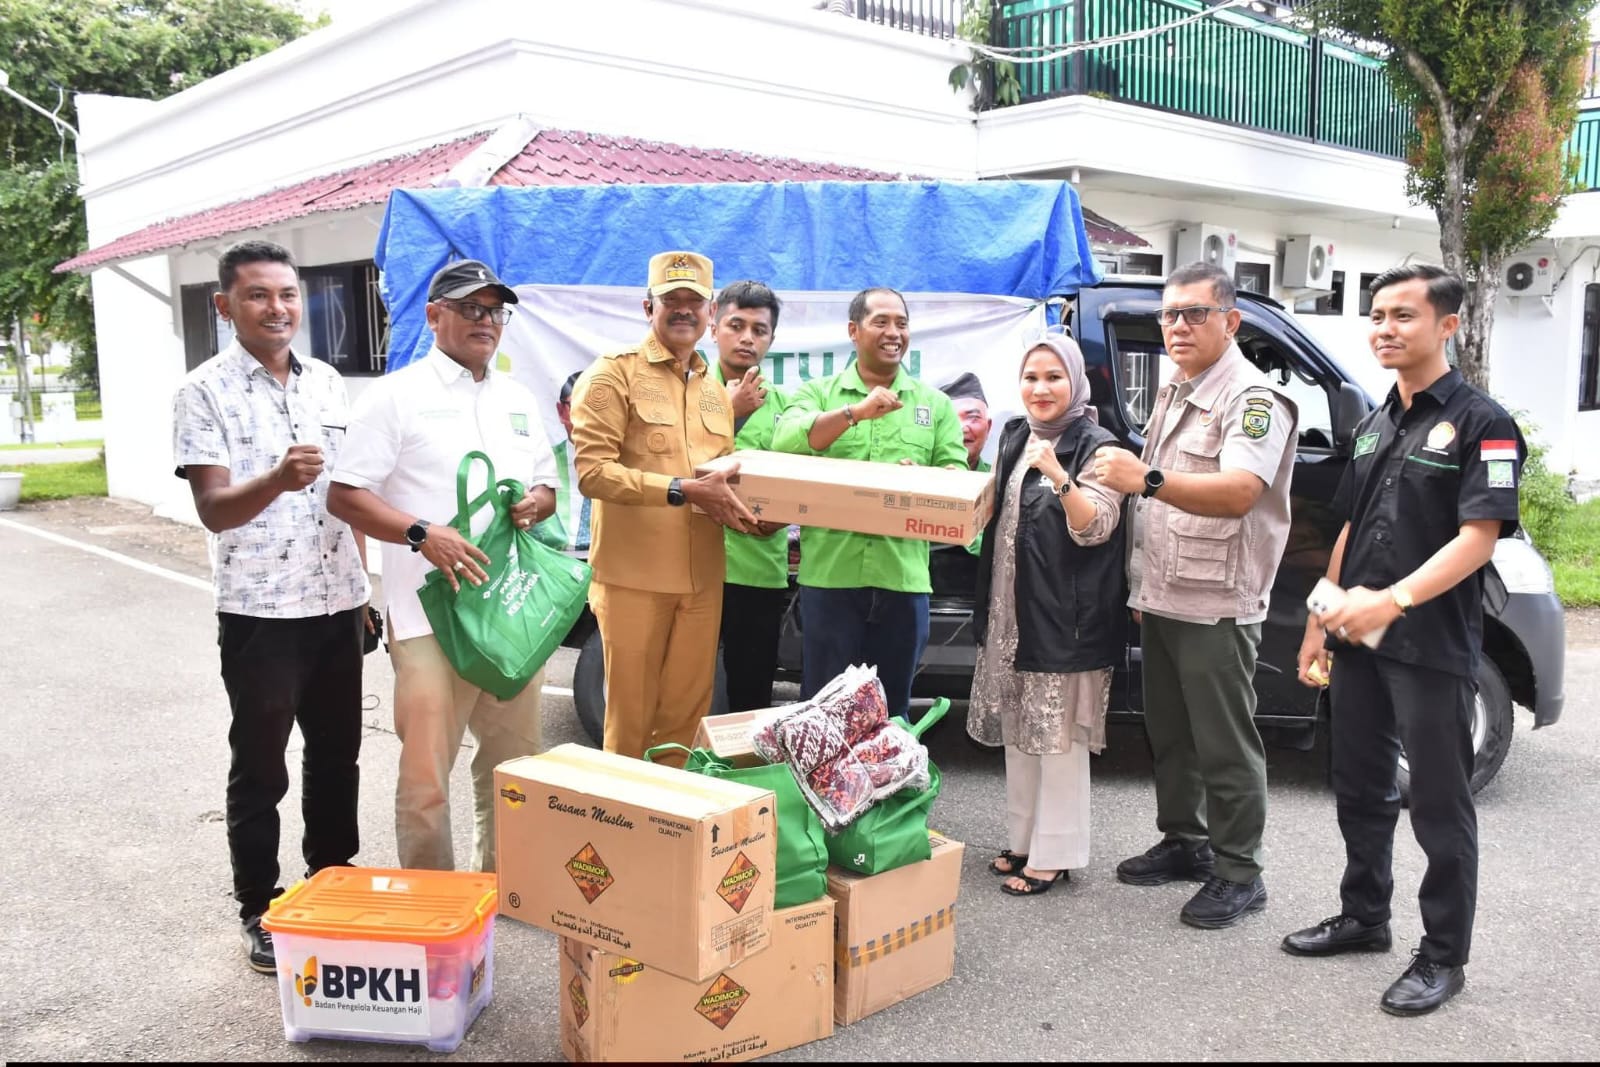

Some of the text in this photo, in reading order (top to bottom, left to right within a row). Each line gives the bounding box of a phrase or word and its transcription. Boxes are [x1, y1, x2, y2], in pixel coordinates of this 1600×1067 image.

[905, 518, 965, 539] Rinnai
[548, 796, 635, 830] Busana Muslim
[648, 815, 694, 833] INTERNATIONAL
[658, 827, 682, 839] QUALITY
[711, 832, 766, 858] Busana Muslim
[572, 860, 606, 877] WADIMOR
[722, 868, 755, 887] WADIMOR
[785, 911, 828, 925] INTERNATIONAL
[794, 920, 817, 930] QUALITY
[322, 964, 420, 1002] BPKH
[703, 990, 741, 1005] WADIMOR
[315, 1000, 422, 1015] Badan Pengelola Keuangan Haji
